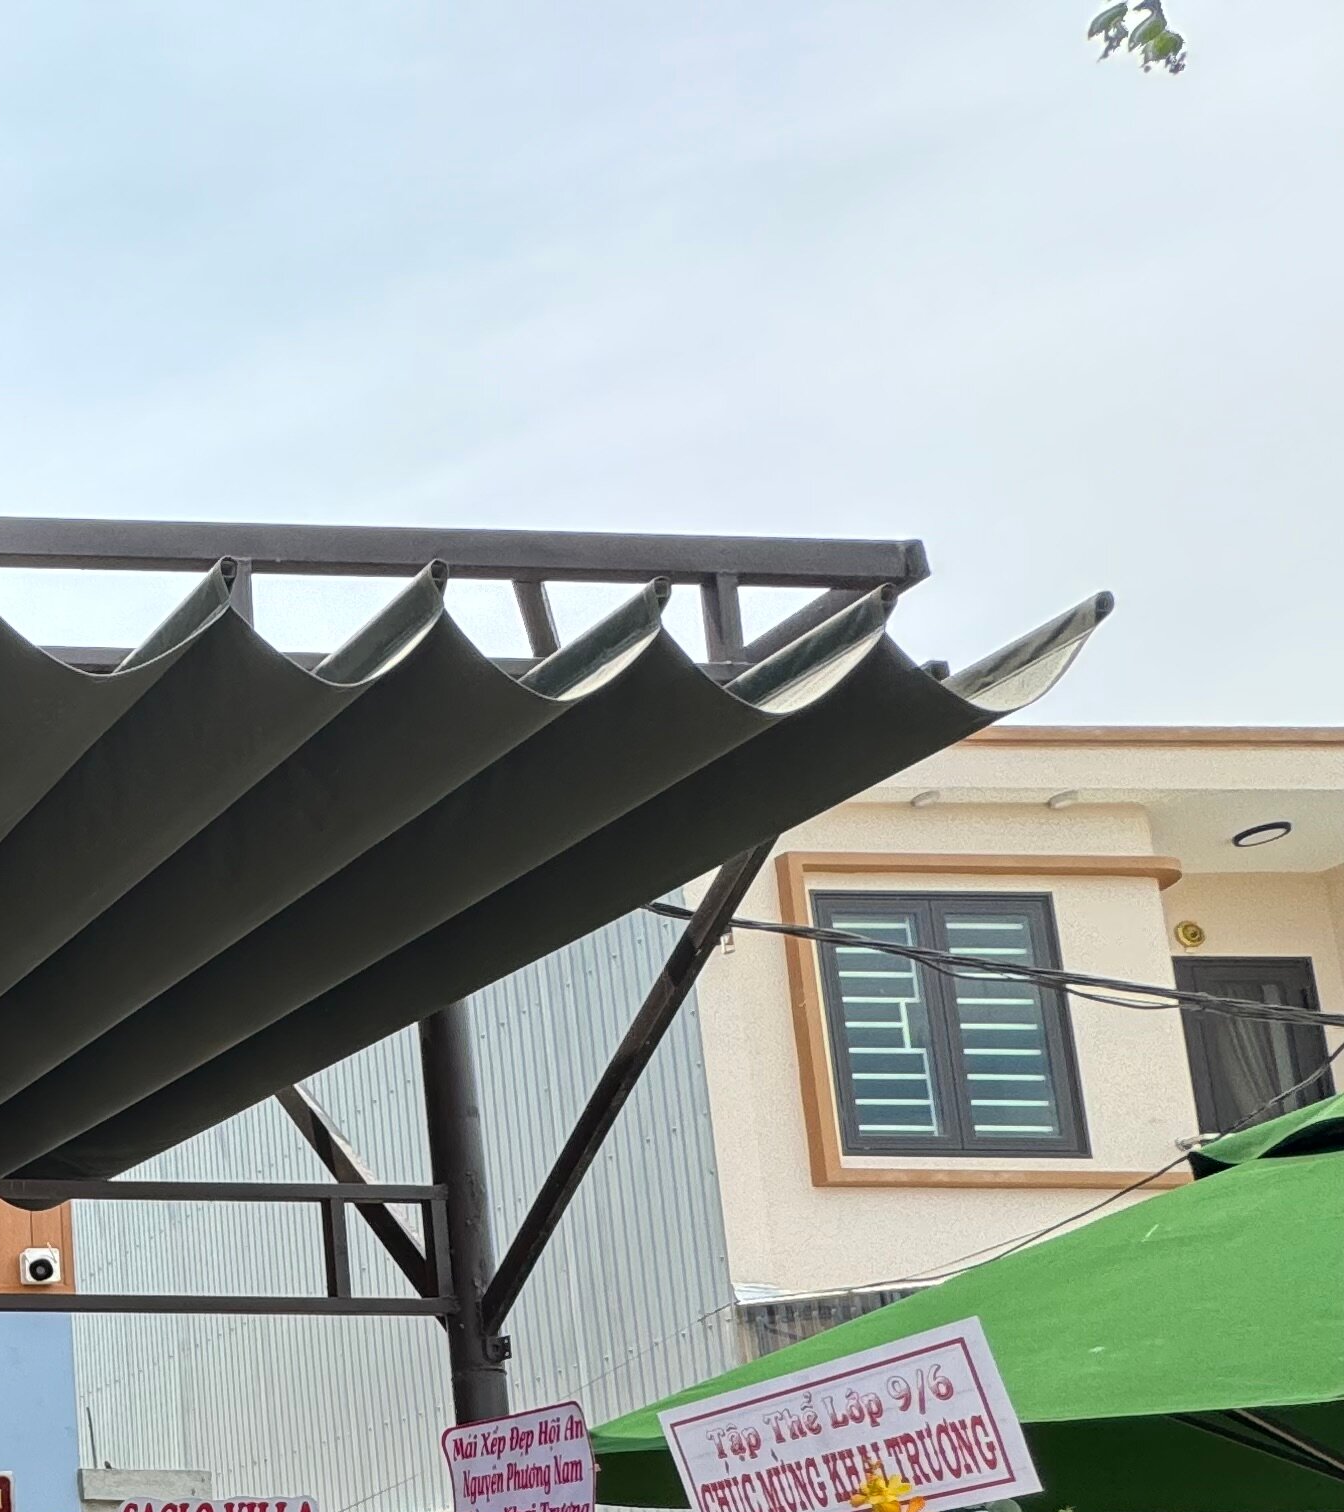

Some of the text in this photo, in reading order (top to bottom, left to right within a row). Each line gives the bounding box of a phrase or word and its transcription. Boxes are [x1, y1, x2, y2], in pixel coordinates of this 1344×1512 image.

[706, 1363, 953, 1463] Tập Thể Lớp 9/6
[453, 1415, 584, 1462] Mái Xếp Đẹp Hội An
[554, 1455, 583, 1485] Nam
